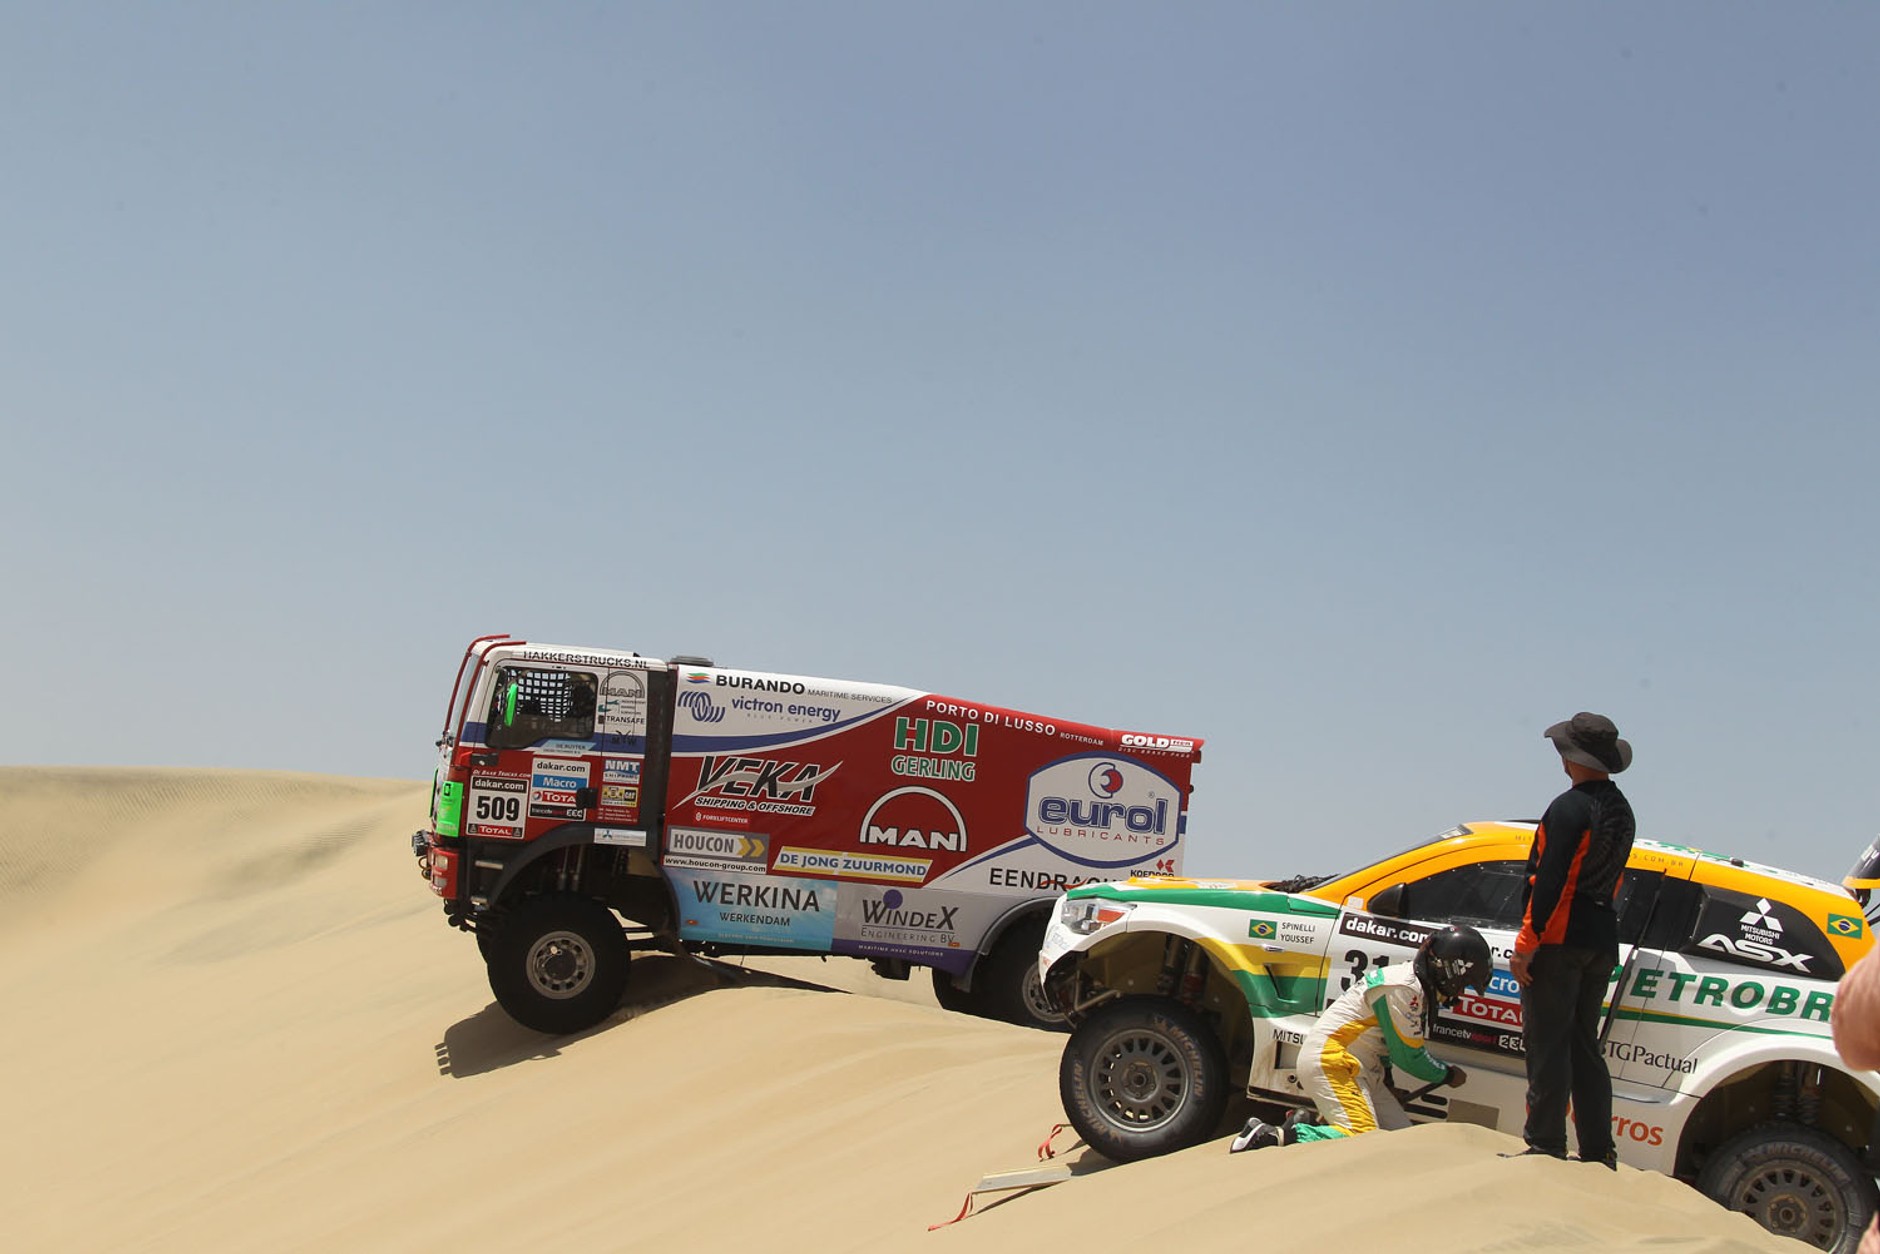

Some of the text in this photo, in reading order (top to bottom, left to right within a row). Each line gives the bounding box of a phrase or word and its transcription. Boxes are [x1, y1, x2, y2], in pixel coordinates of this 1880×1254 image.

[523, 650, 650, 669] HAKKERSTRUCKS.NL
[716, 675, 893, 704] BURANDO MARITIME SERVICES
[732, 695, 841, 722] victron energy
[607, 715, 645, 725] TRANSAFE
[926, 700, 1104, 746] PORTO DI LUSSO ROTTERDAM
[894, 716, 979, 757] HDI
[1121, 734, 1169, 748] GOLD
[537, 761, 585, 773] dakar.com
[605, 760, 640, 771] NMT
[892, 756, 975, 782] GERLING
[474, 779, 524, 791] dakar.com
[543, 777, 577, 788] Macro
[697, 755, 820, 802] VEKA
[544, 791, 576, 803] TOTA
[695, 797, 816, 816] SHIPPING & OFFSHORE
[477, 796, 520, 822] 509
[1038, 796, 1168, 836] eurol
[480, 826, 512, 836] TOTAL
[868, 825, 958, 851] MAN
[1036, 825, 1165, 847] LUBRICANTS
[674, 834, 734, 853] HOUCON
[665, 857, 766, 873] www.houcon-group.com
[780, 853, 927, 876] DE JONG ZUURMOND
[989, 867, 1110, 890] EENDRA
[693, 880, 820, 913] WERKINA
[719, 912, 791, 927] WERKENDAM
[1281, 922, 1316, 933] SPINELLI
[861, 927, 936, 943] ENGINEERING
[1280, 933, 1315, 944] YOUSSEF
[1740, 924, 1780, 940] MITSUBISHI
[1744, 933, 1773, 945] MOTORS
[1696, 933, 1814, 974] ASX
[1341, 948, 1390, 991] 3
[1489, 976, 1519, 993] cro
[1604, 962, 1832, 1021] ETROBR
[1458, 995, 1522, 1023] TOTA
